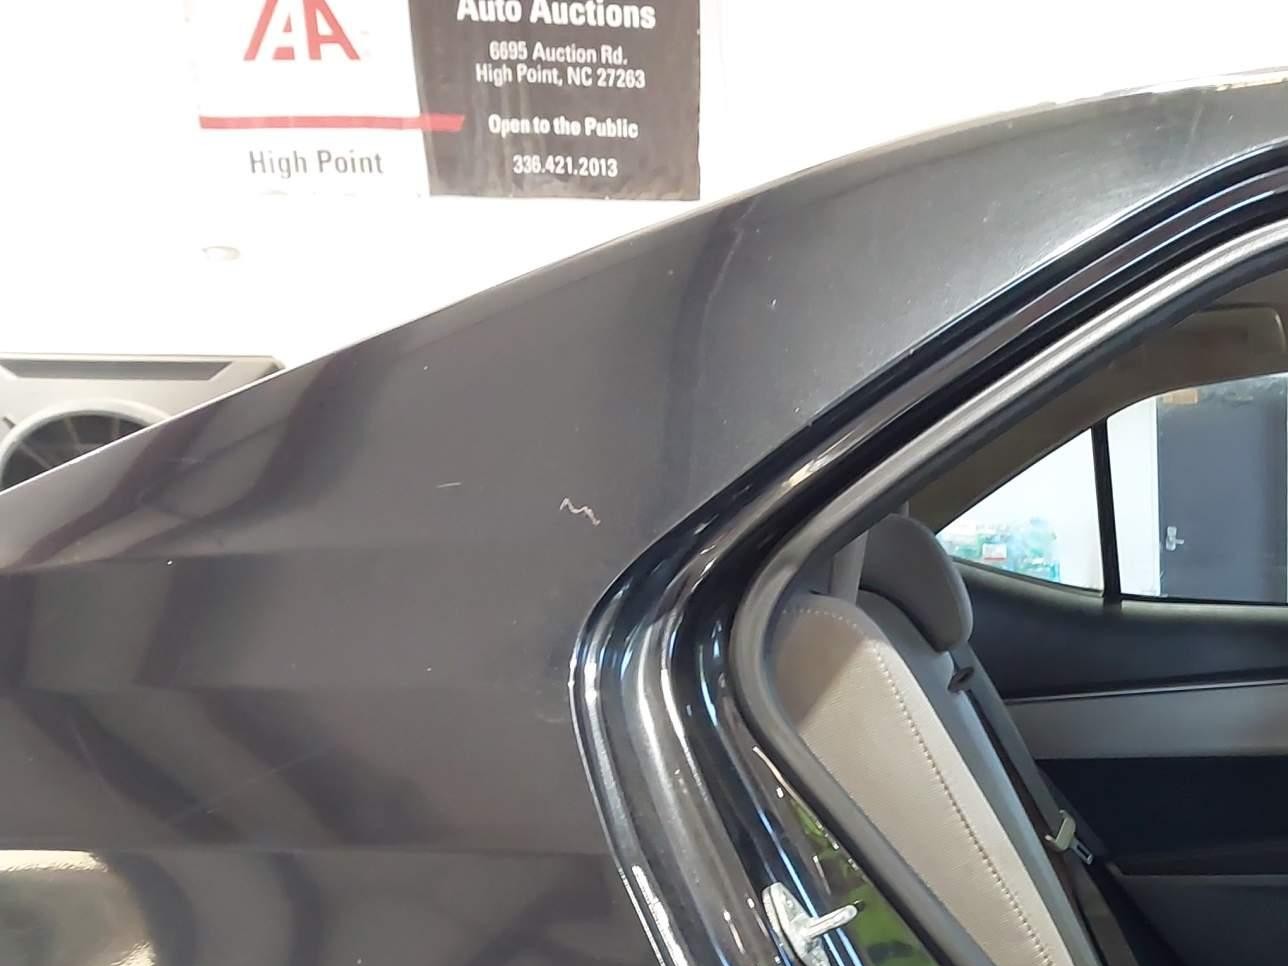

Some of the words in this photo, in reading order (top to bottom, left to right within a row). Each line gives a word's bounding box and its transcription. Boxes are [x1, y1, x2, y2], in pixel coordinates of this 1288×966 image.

[457, 0, 522, 23] Auto
[529, 0, 657, 29] Auctions
[489, 40, 528, 61] 6695
[532, 41, 597, 64] Auction
[600, 44, 629, 66] Rd.
[475, 62, 514, 87] High
[516, 63, 563, 86] Point,
[567, 66, 593, 86] NC
[597, 67, 646, 88] 27263
[488, 113, 531, 139] Open
[534, 116, 551, 134] to
[553, 116, 582, 136] the
[584, 117, 640, 138] Public
[249, 150, 309, 179] High
[316, 150, 384, 175] Point
[513, 154, 619, 177] 336.421.2013
